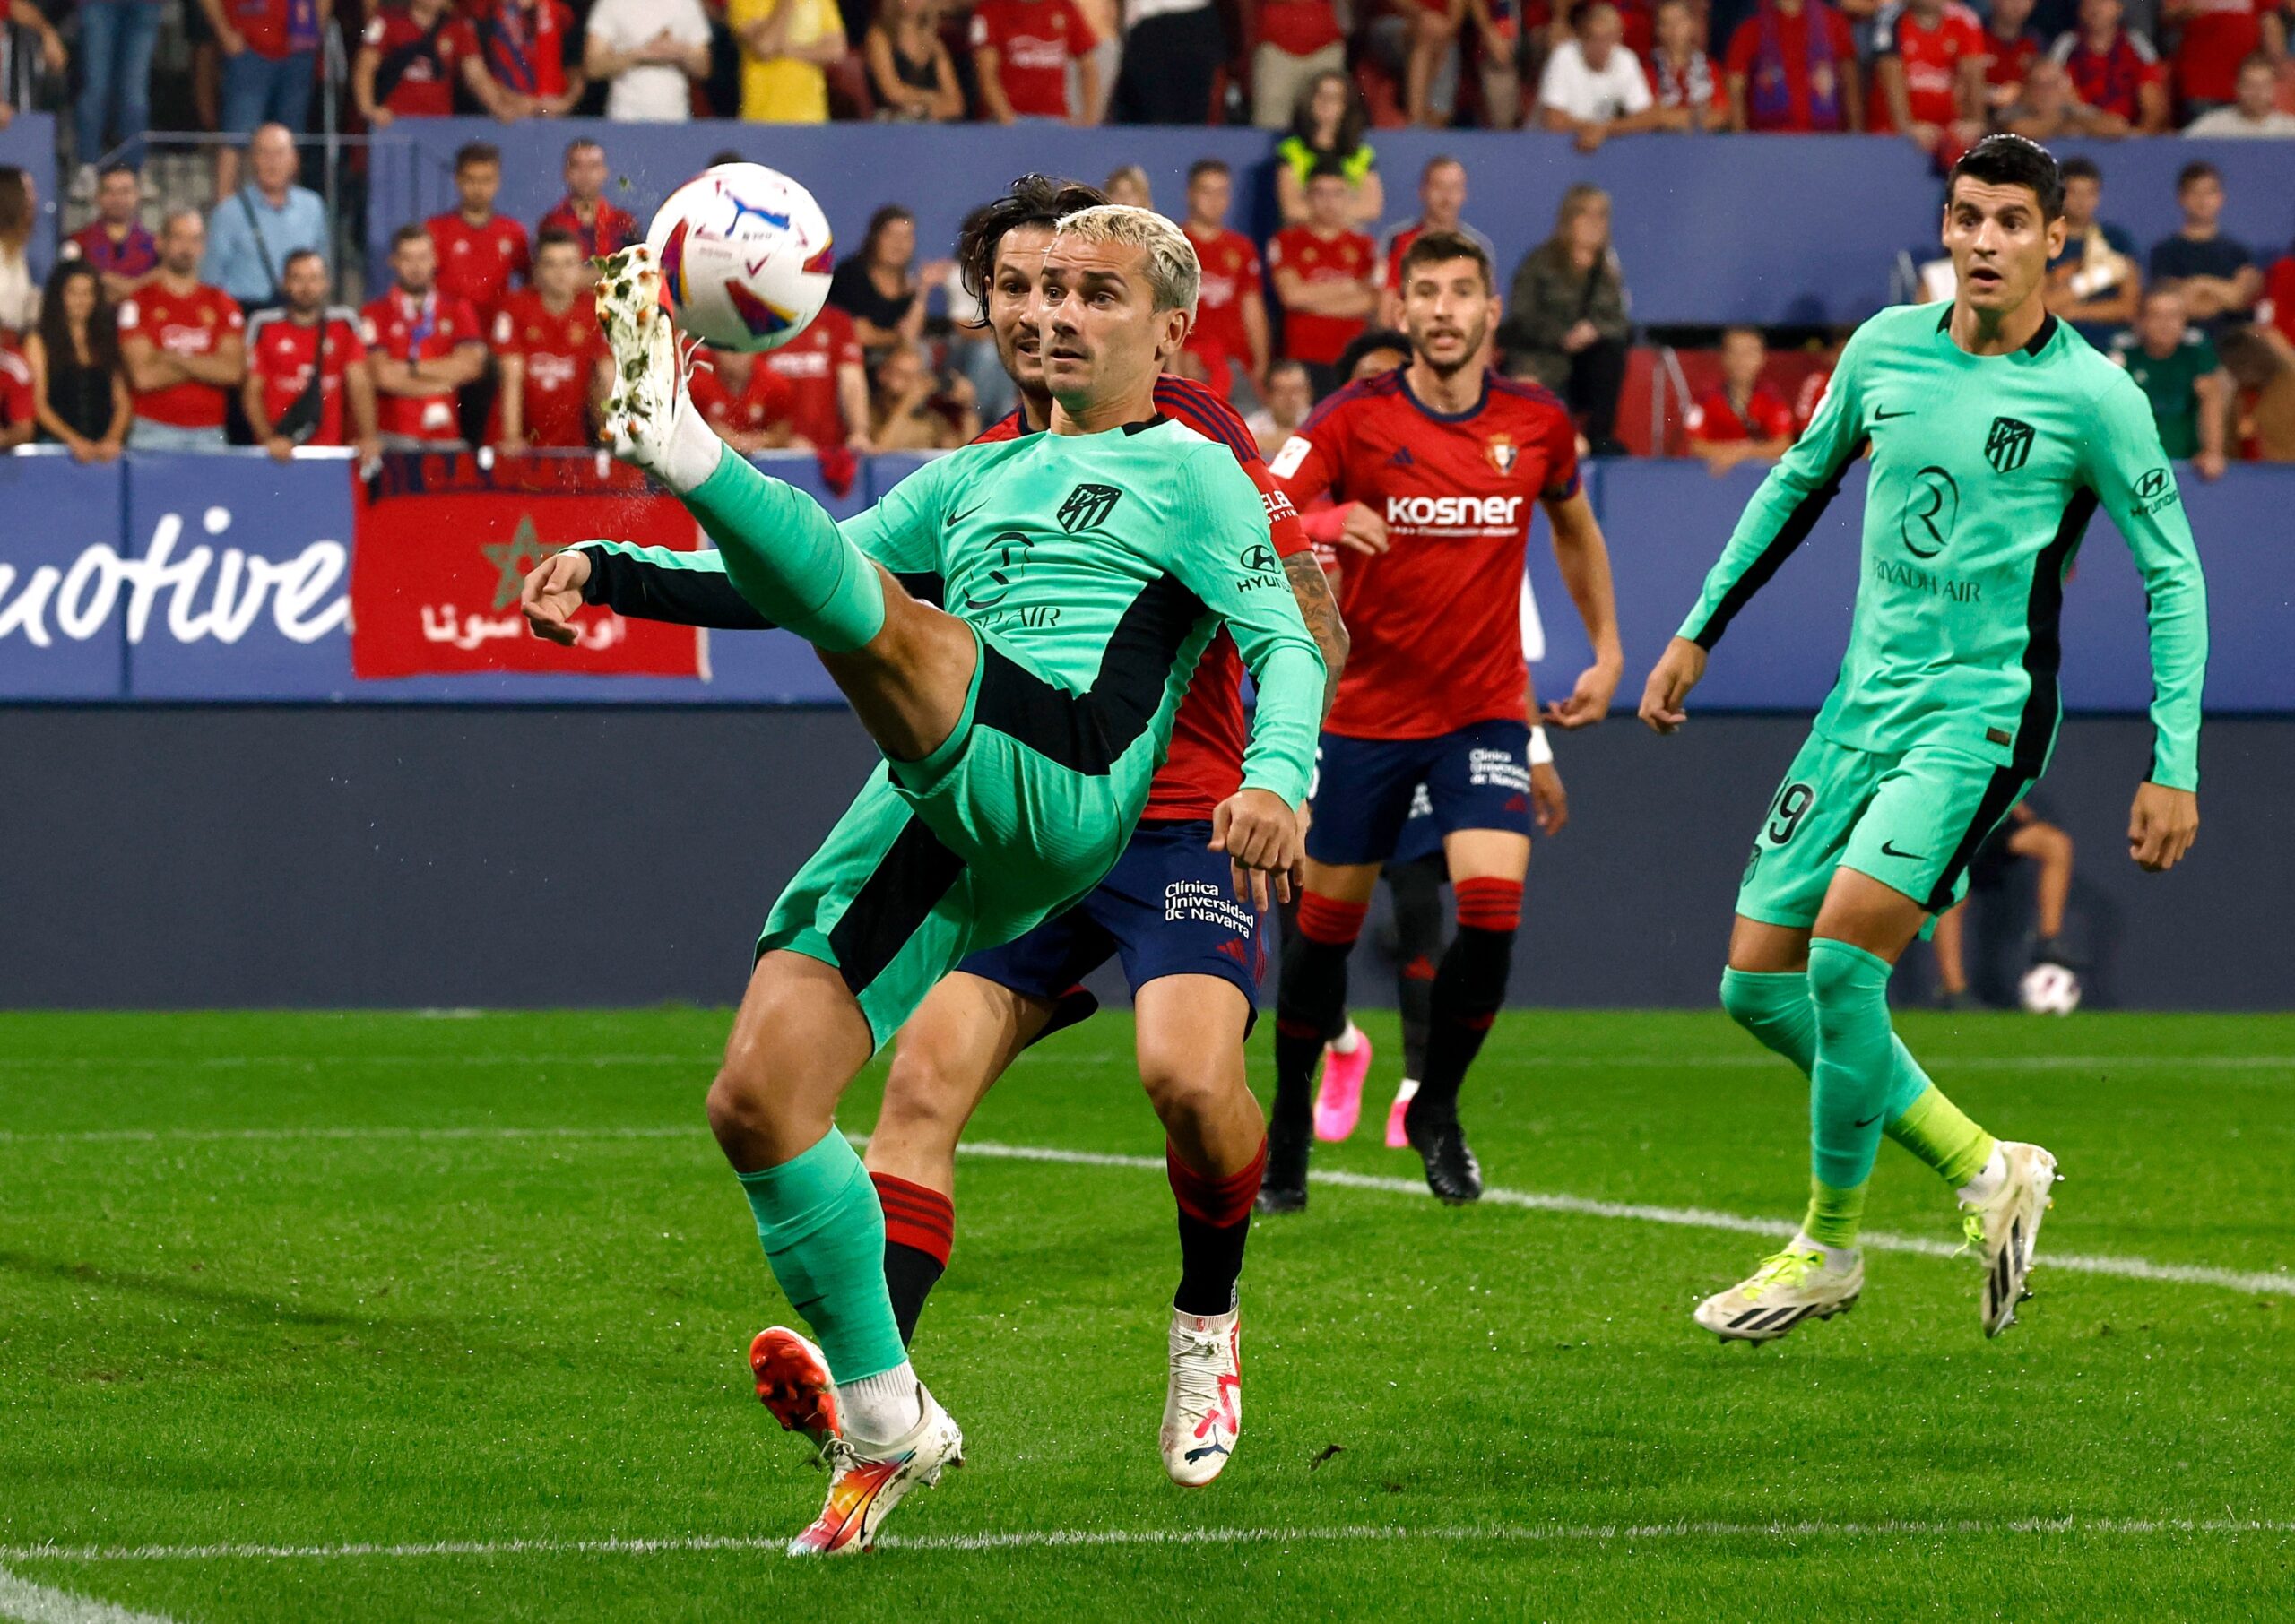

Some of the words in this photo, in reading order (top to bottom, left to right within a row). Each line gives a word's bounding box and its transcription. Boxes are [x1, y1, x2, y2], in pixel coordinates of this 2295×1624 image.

[1942, 580, 1981, 603] AIR
[1005, 606, 1061, 627] AIR
[1165, 879, 1219, 898] Clínica
[1165, 893, 1254, 929] Universidad
[1165, 905, 1185, 921] de
[1191, 907, 1250, 939] Navarra
